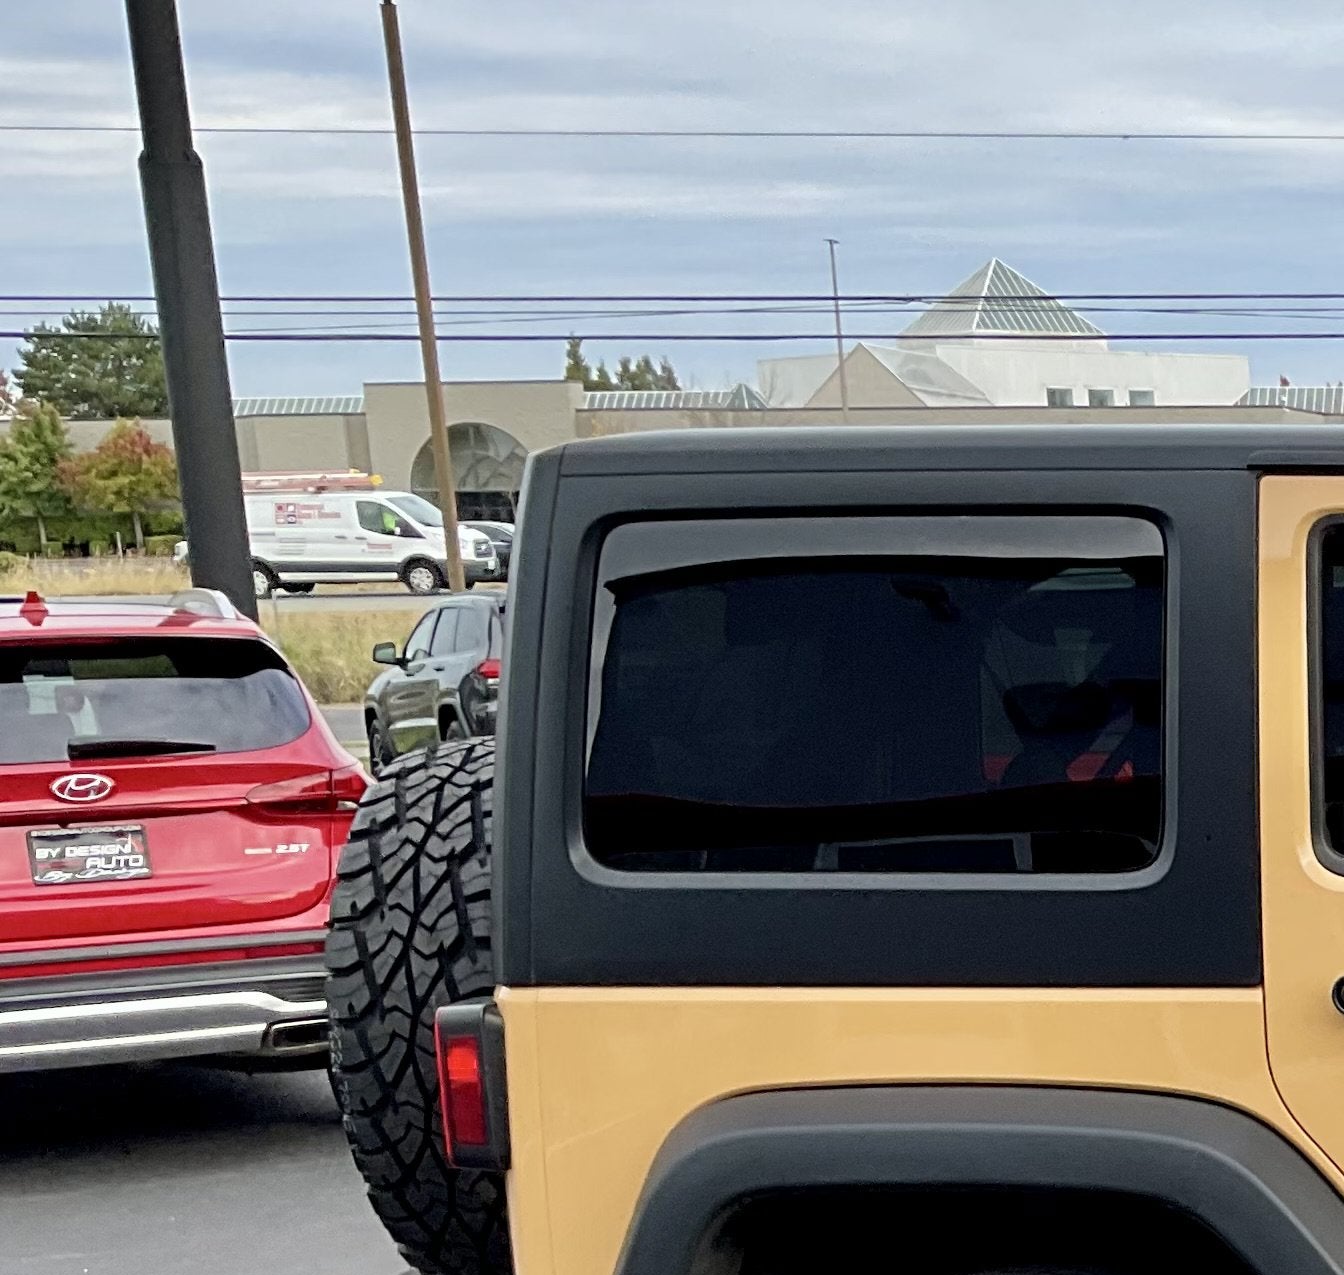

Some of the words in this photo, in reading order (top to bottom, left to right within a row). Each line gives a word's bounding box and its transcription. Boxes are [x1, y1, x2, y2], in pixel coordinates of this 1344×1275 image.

[35, 847, 61, 860] BY
[64, 843, 132, 858] DESIGN
[85, 854, 144, 870] AUTO
